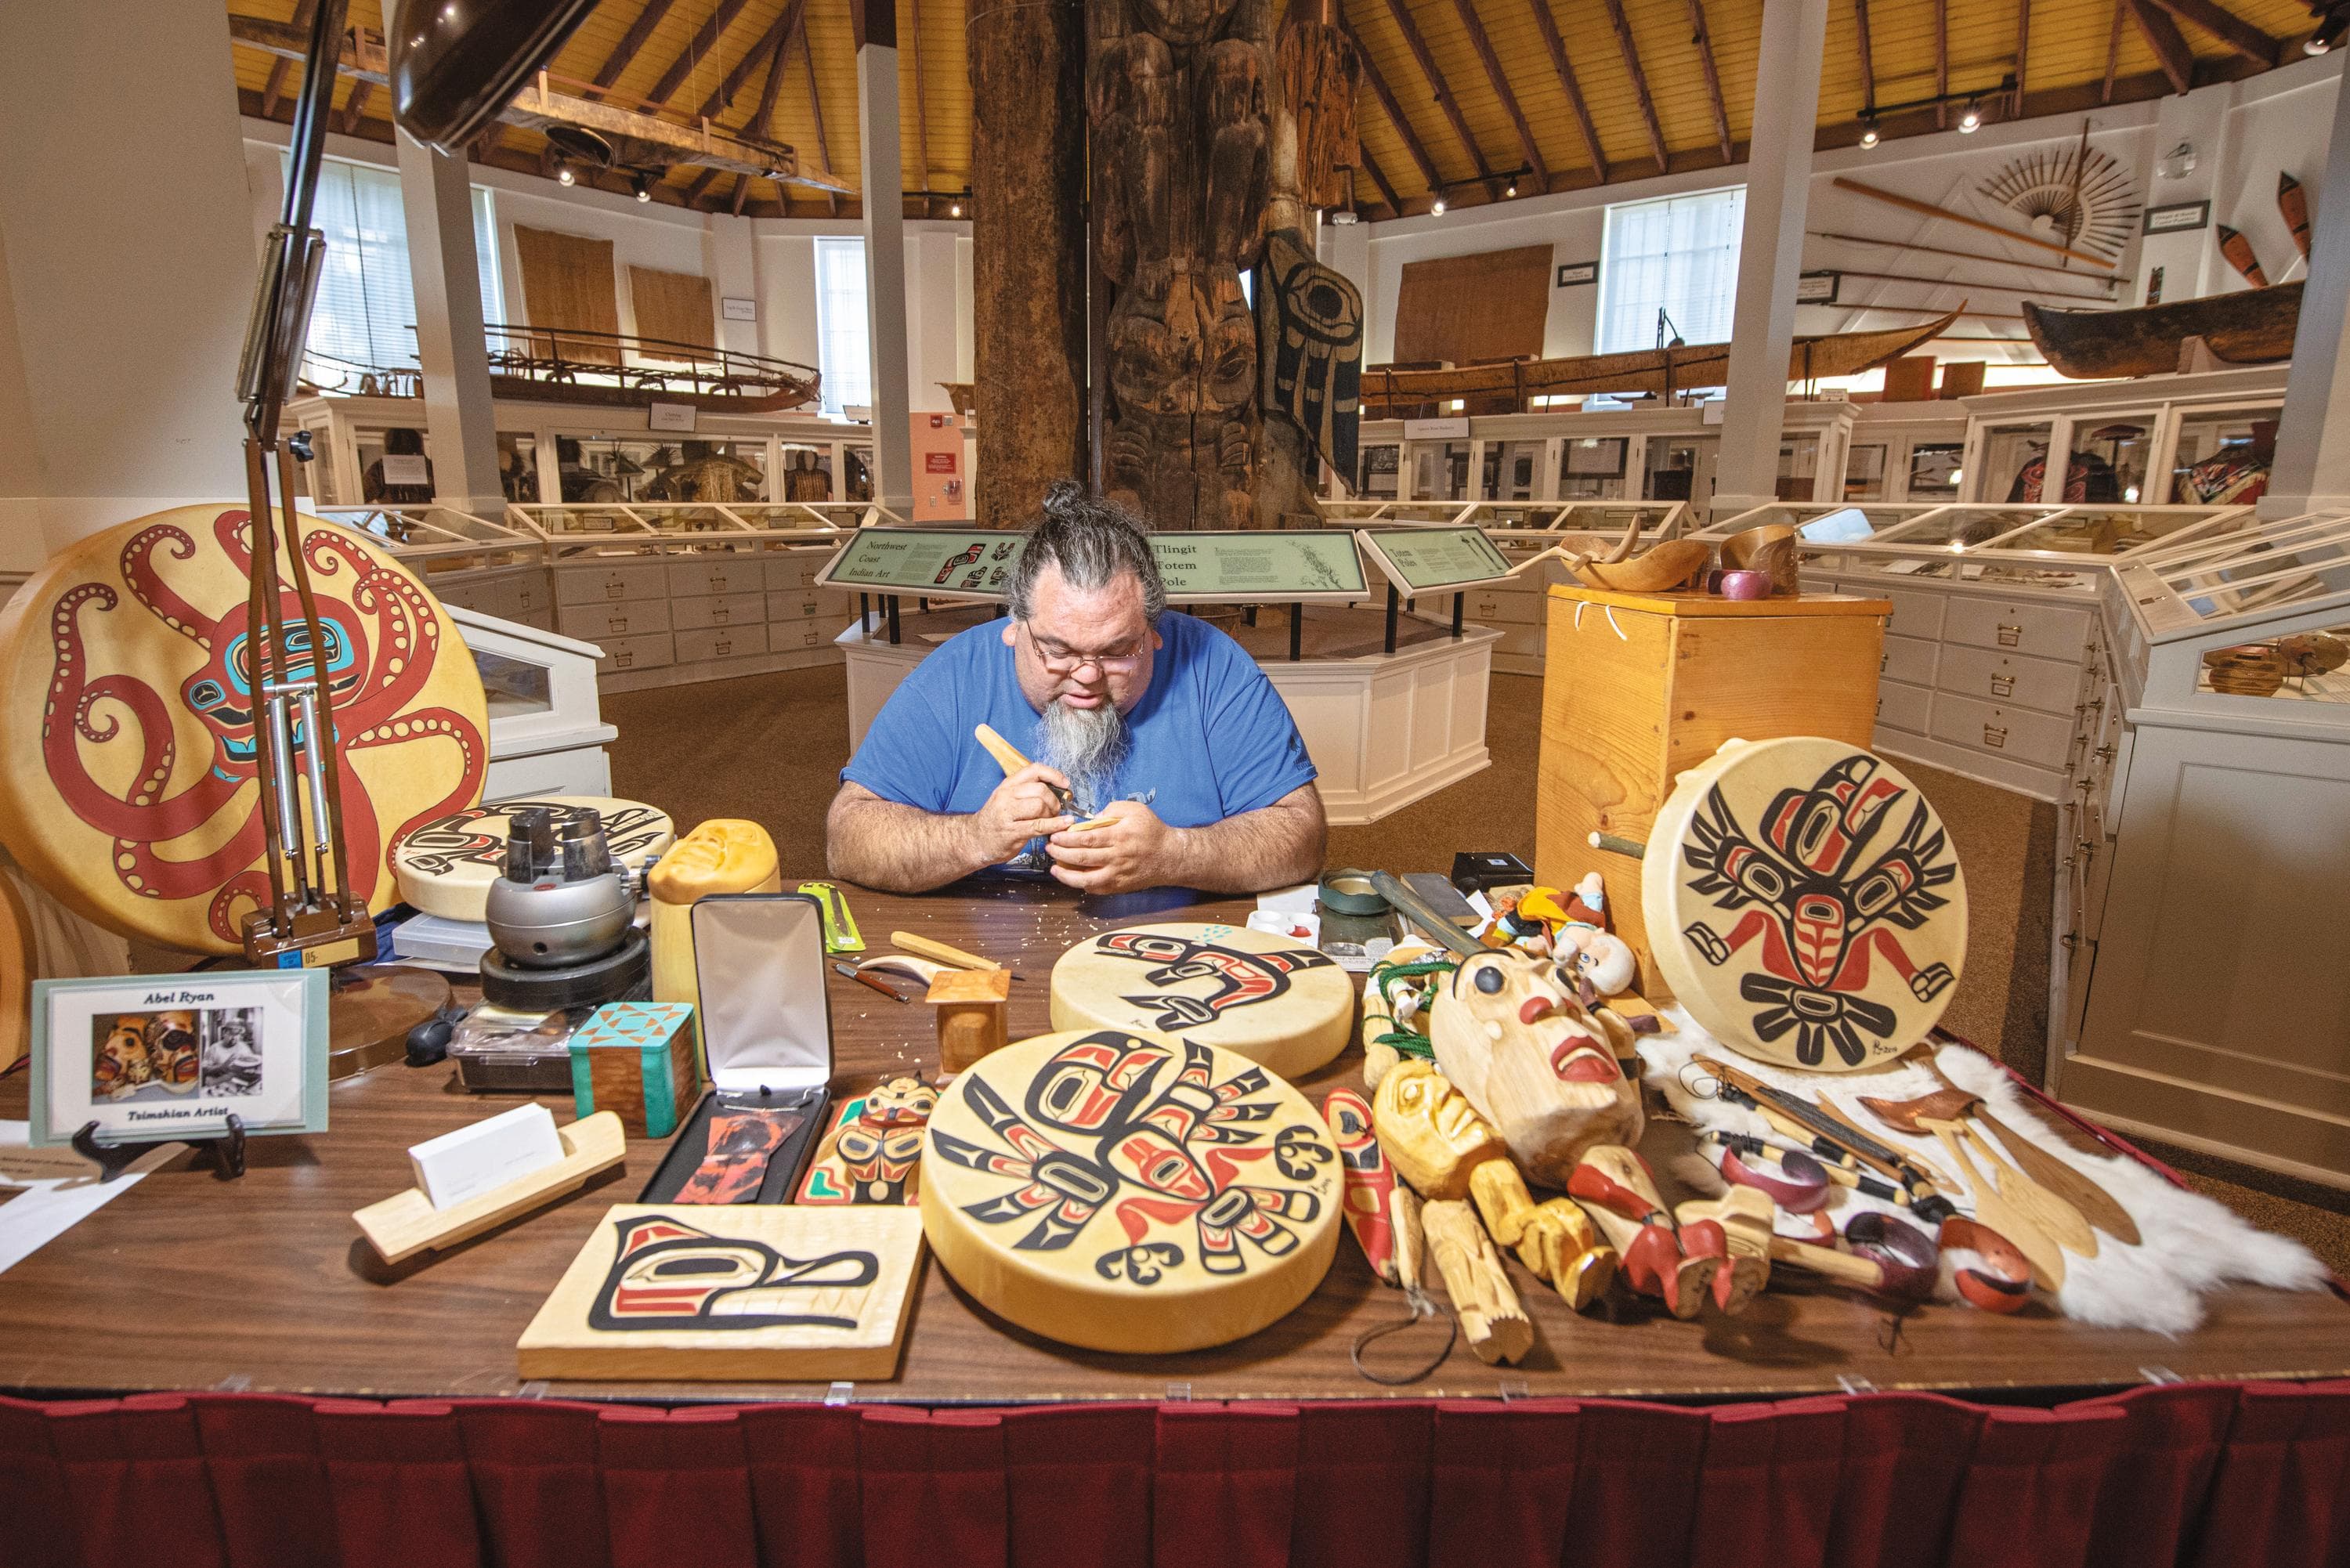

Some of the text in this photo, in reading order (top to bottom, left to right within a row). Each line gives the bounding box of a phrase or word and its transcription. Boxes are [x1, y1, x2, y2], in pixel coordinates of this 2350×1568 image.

[866, 541, 907, 551] Northwest
[1152, 544, 1197, 555] Tlingit
[859, 554, 881, 563] Coast
[1155, 561, 1197, 569] Totem
[849, 568, 891, 578] Indian Art
[144, 992, 215, 1004] Abel Ryan
[193, 1107, 229, 1118] Artist
